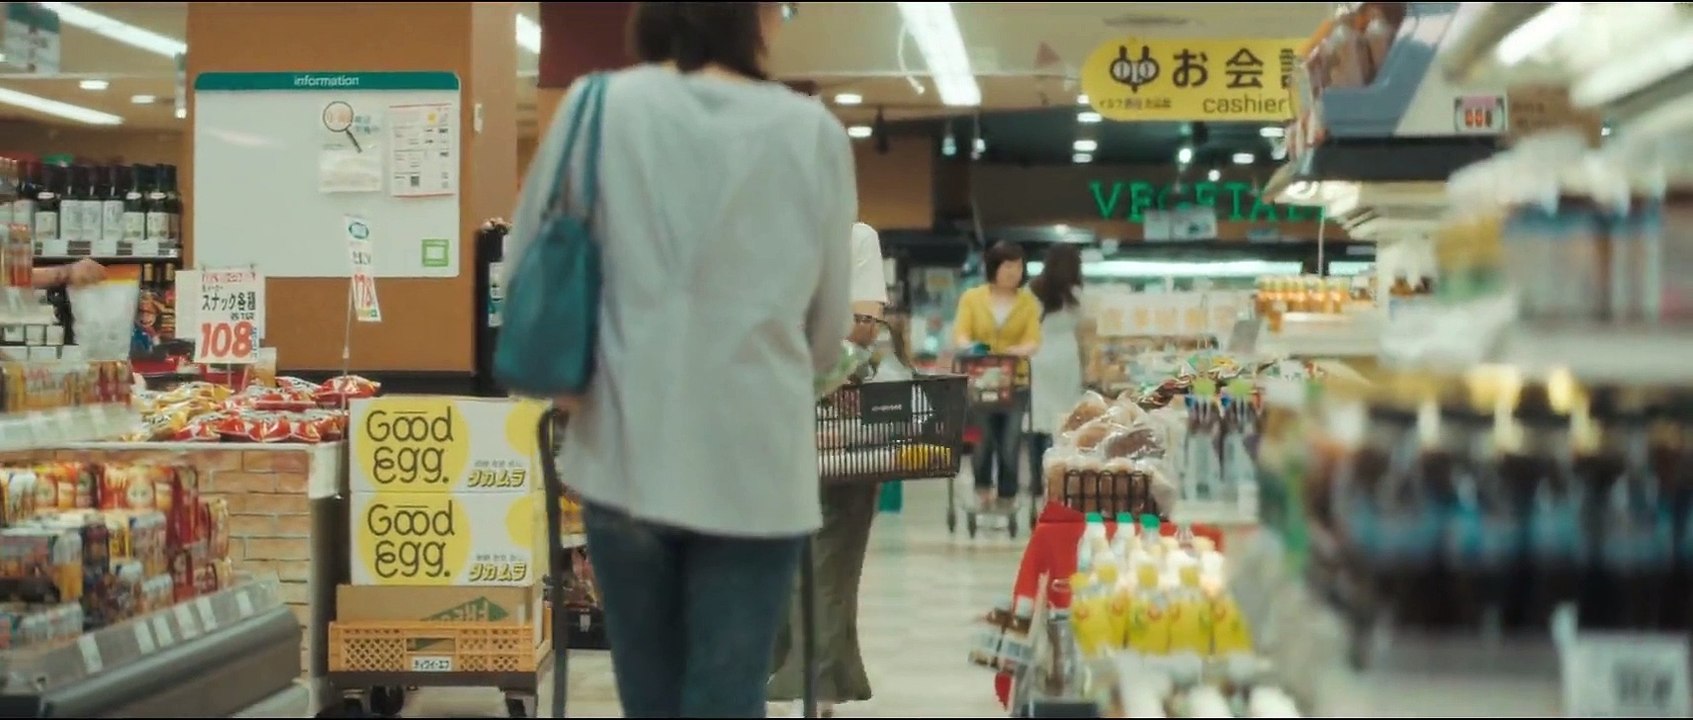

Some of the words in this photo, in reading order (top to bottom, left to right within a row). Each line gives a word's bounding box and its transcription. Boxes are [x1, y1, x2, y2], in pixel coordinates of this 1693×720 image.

[294, 75, 359, 86] information
[1202, 94, 1285, 114] cashier
[200, 321, 253, 358] 108
[366, 406, 454, 442] Good
[467, 468, 527, 488] タカムラ
[367, 500, 455, 536] Good
[468, 562, 528, 581] タカムラ
